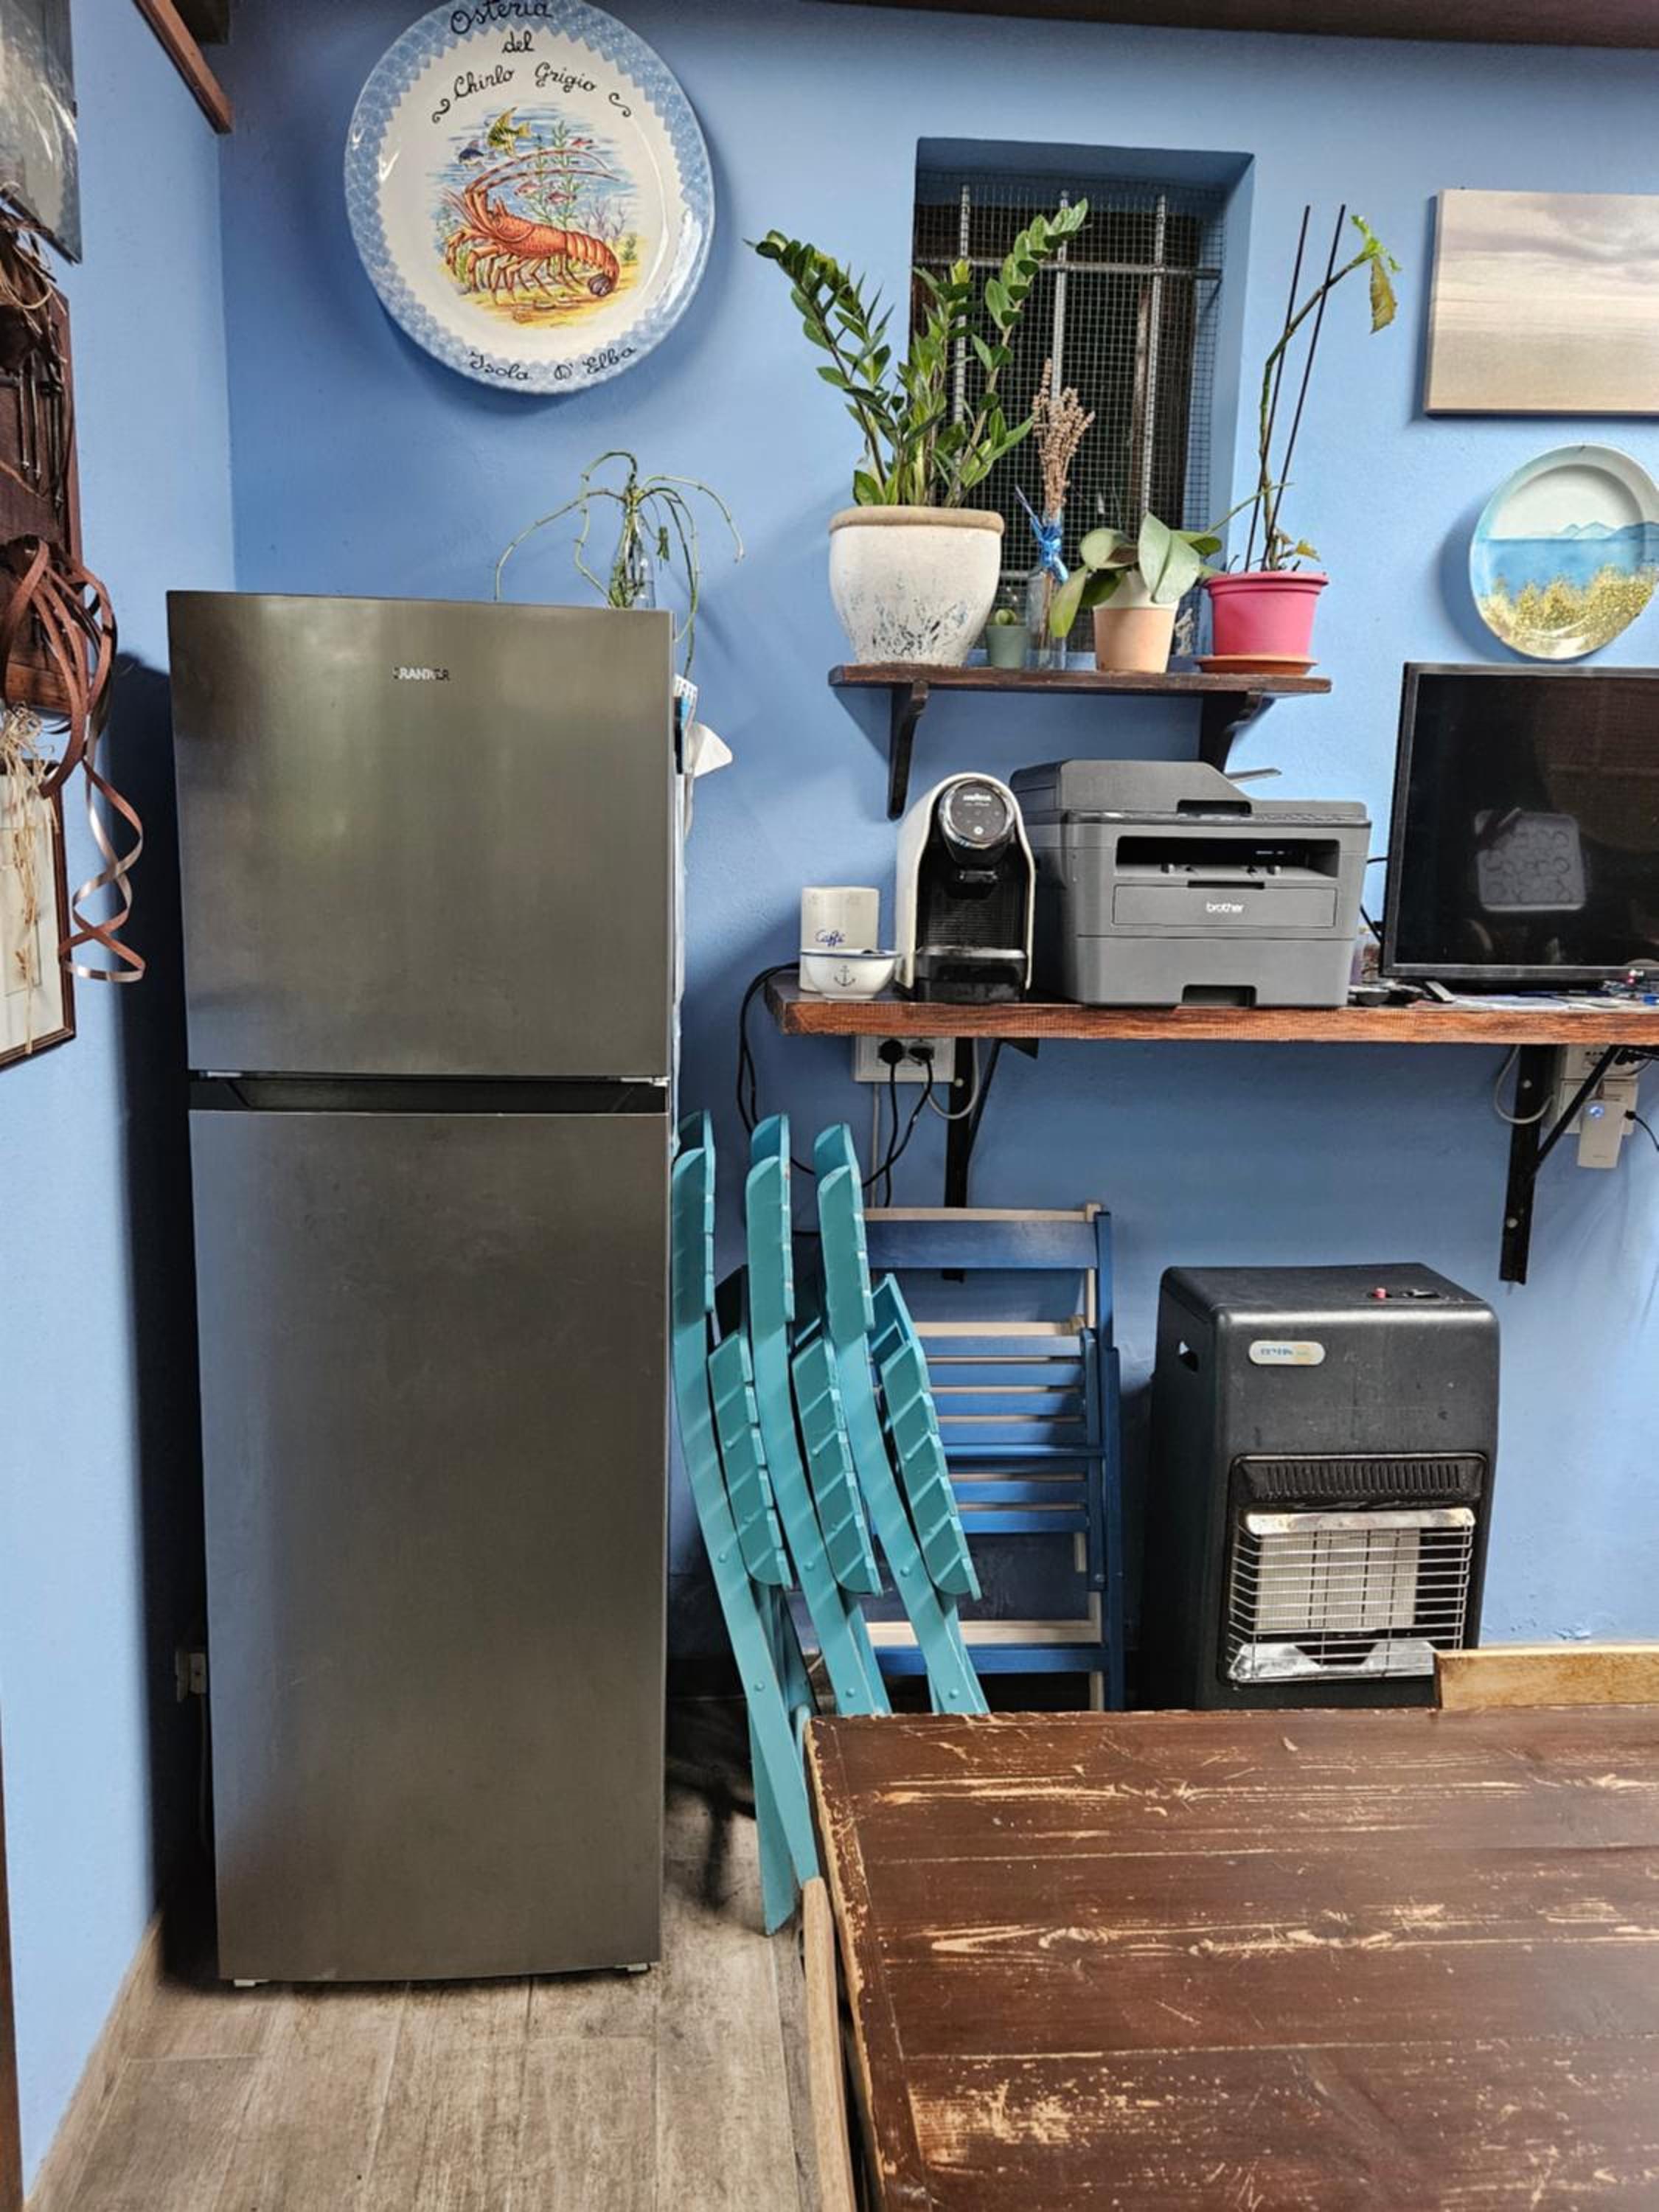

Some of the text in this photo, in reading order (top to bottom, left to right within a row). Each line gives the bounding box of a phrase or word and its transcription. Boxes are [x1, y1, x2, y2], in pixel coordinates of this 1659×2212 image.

[501, 29, 535, 53] del
[534, 61, 597, 94] Grigio
[470, 350, 529, 380] Isola
